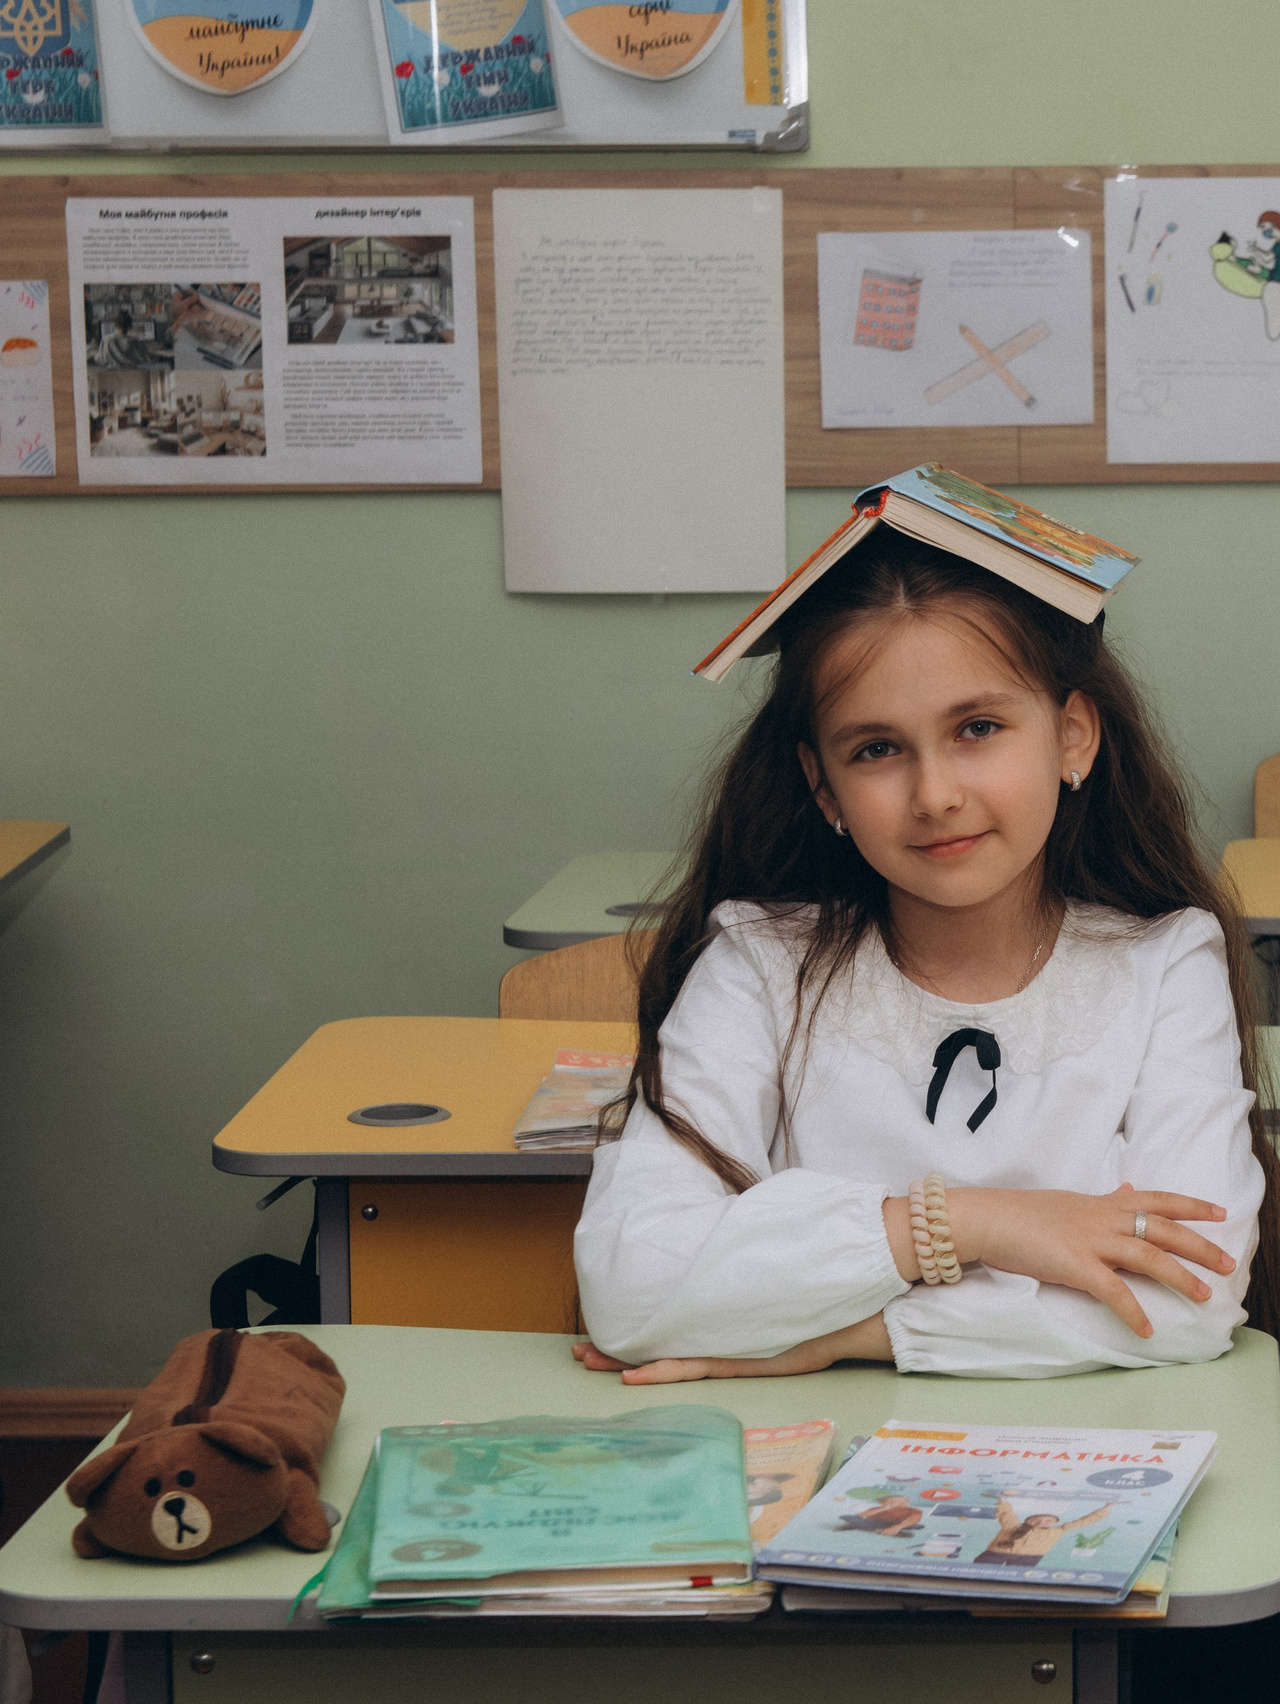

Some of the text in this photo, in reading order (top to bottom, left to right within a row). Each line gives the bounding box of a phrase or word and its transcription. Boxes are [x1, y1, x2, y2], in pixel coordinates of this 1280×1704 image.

[617, 31, 694, 61] Україна
[199, 45, 280, 78] України!
[99, 207, 229, 221] Моя майбутня професія
[315, 205, 368, 220] дизайнер
[900, 1444, 1165, 1464] ІНФОРМАТИКА
[1121, 1469, 1146, 1481] 4
